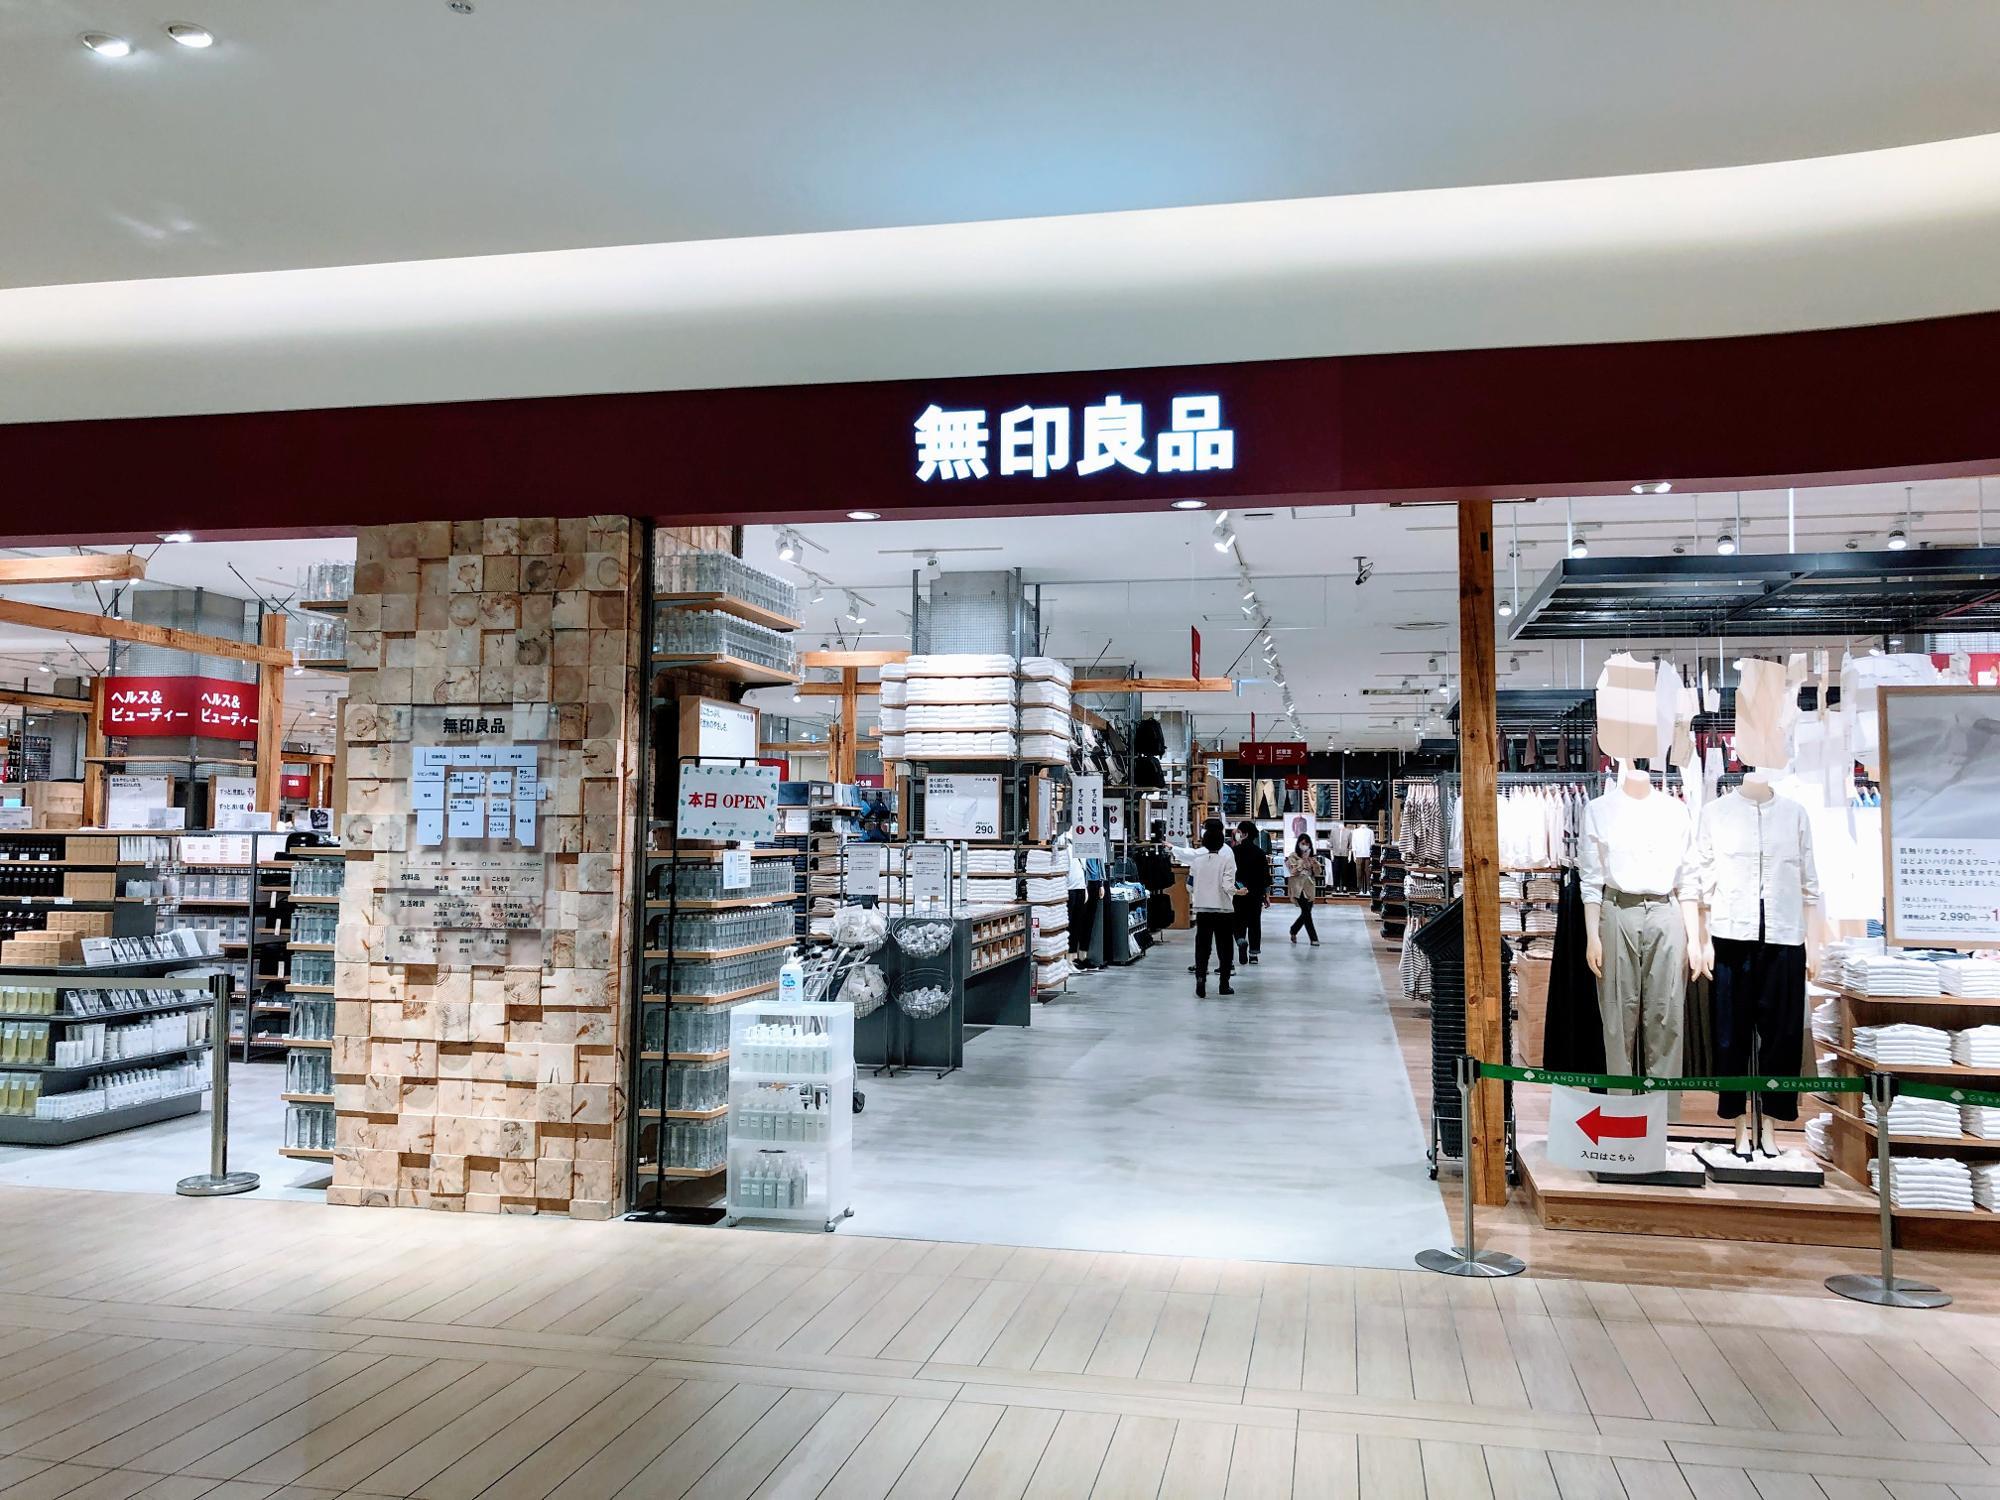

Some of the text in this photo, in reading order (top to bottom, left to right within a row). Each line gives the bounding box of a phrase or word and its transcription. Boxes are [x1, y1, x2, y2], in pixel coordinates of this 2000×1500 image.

[913, 394, 1234, 482] 無印良品
[111, 690, 162, 705] ヘルス&
[201, 692, 241, 709] ヘルス&
[111, 707, 189, 722] ビューティー
[201, 708, 259, 727] ビューティー
[443, 717, 506, 734] 無印良品
[688, 791, 767, 810] 本日 OPEN
[1538, 1073, 1599, 1085] GRANDTREE
[1658, 1079, 1720, 1088] GRANDTREE
[1782, 1080, 1846, 1089] GRANDTREE
[1580, 1150, 1636, 1162] 入口はこちら
